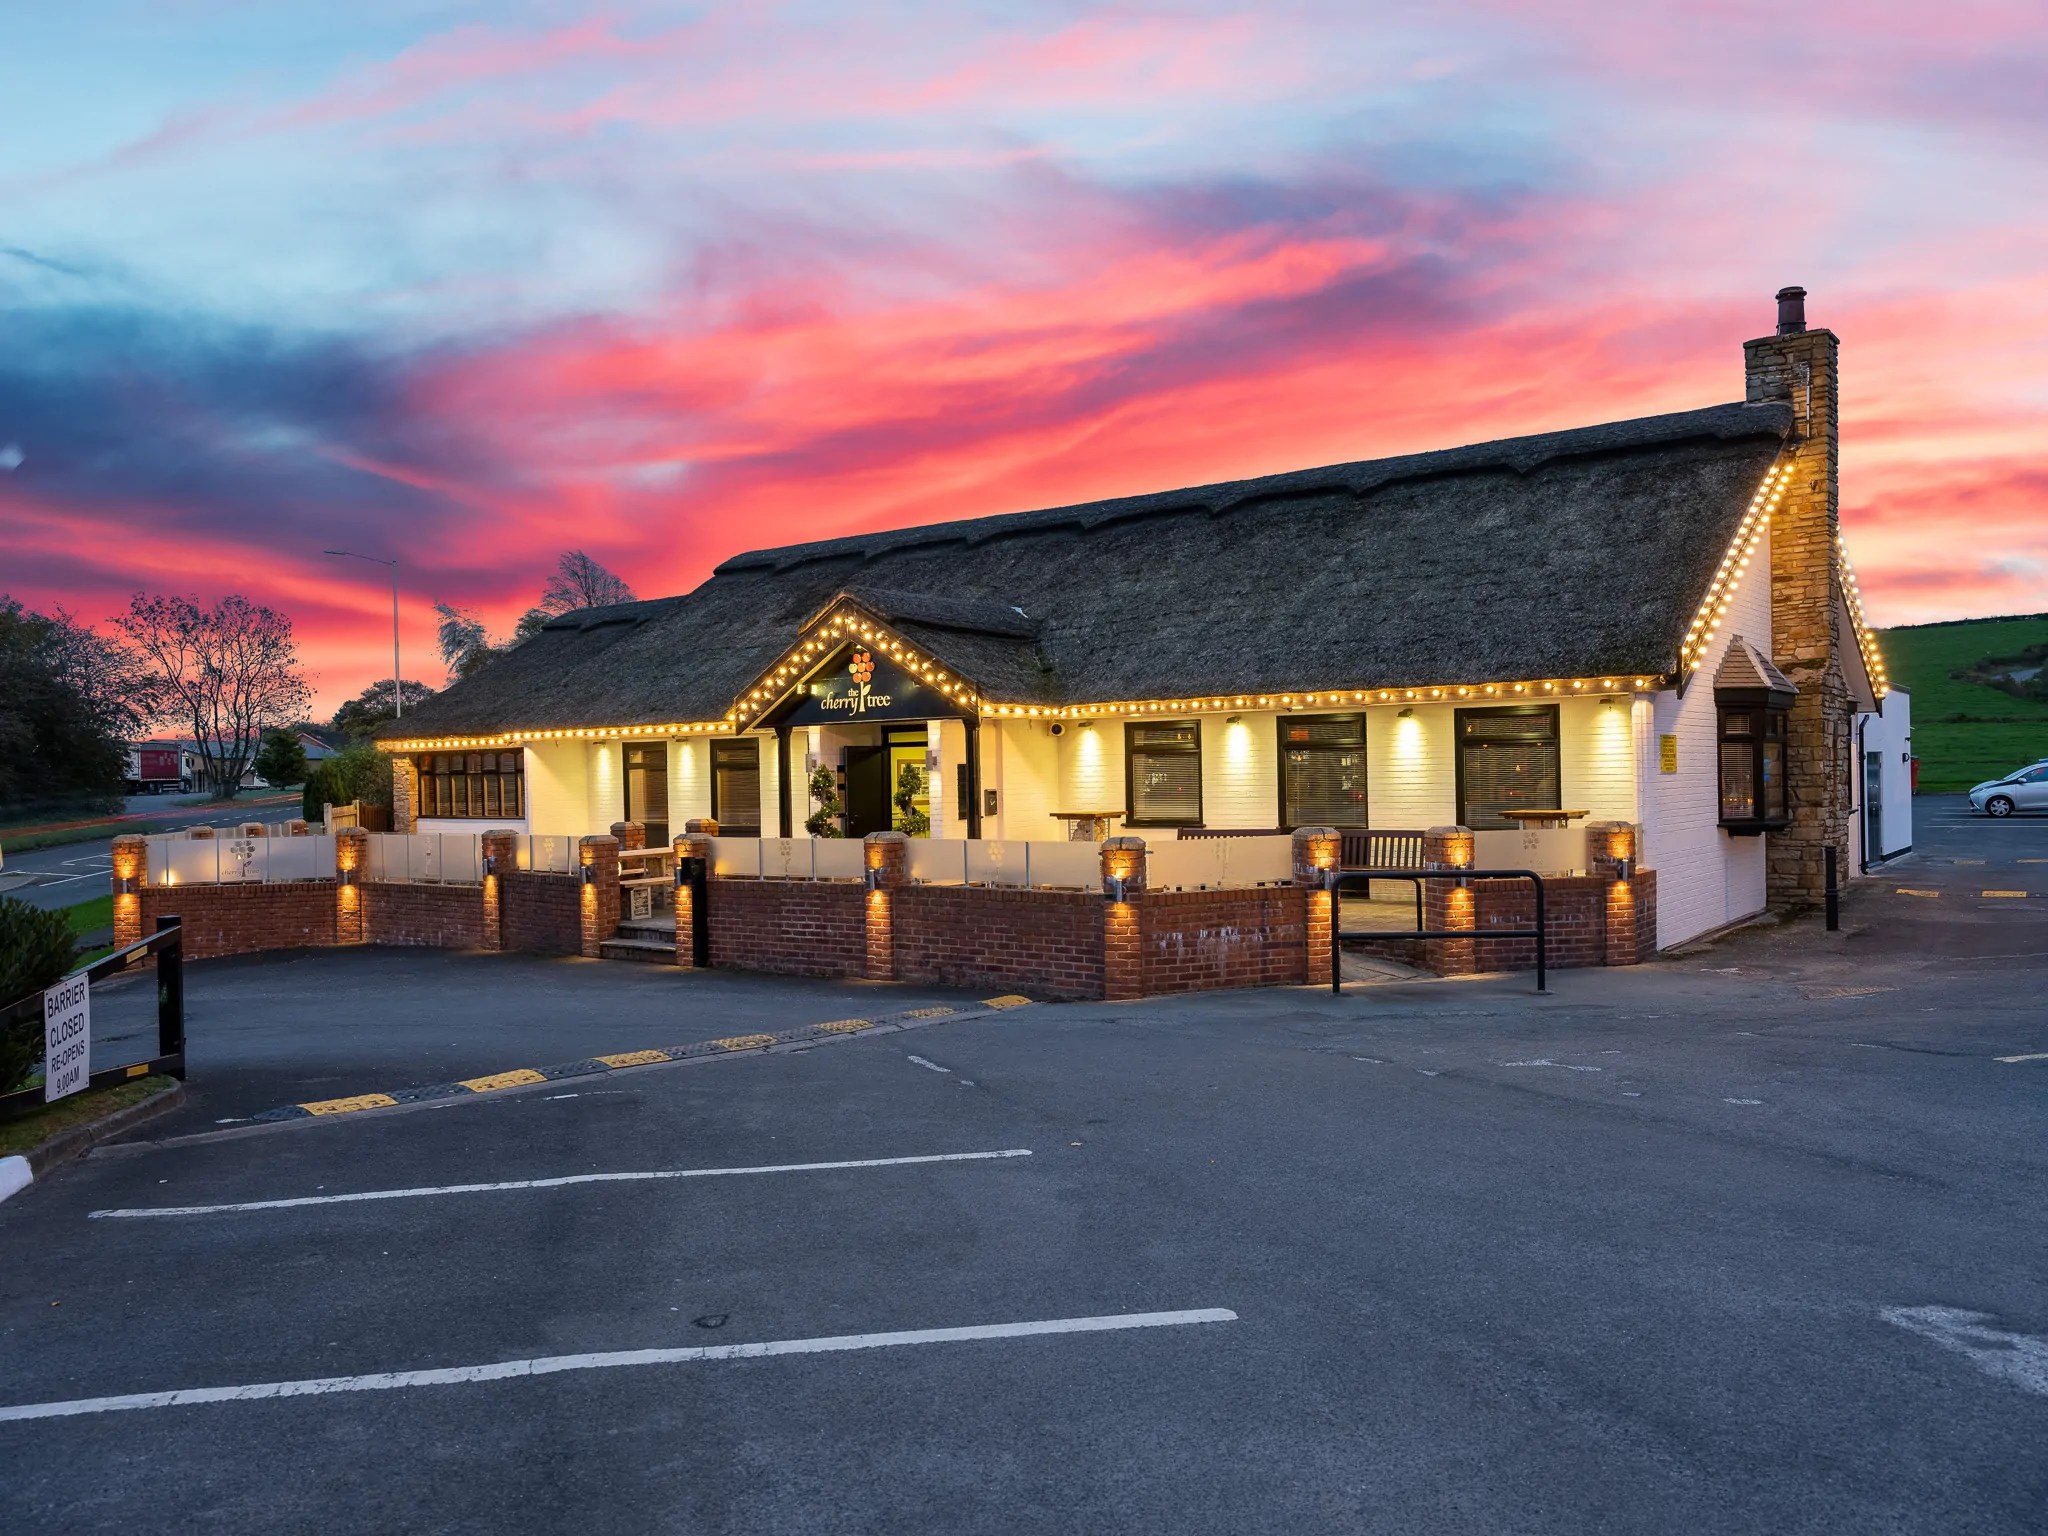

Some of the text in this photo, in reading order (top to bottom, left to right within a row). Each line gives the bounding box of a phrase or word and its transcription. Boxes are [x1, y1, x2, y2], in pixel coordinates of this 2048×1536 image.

[821, 691, 891, 716] cherry tree
[848, 688, 859, 697] the
[47, 982, 86, 1019] BARRIER
[50, 1012, 85, 1049] CLOSED
[51, 1040, 85, 1074] RE-OPENS
[56, 1065, 80, 1094] 9.00AM
